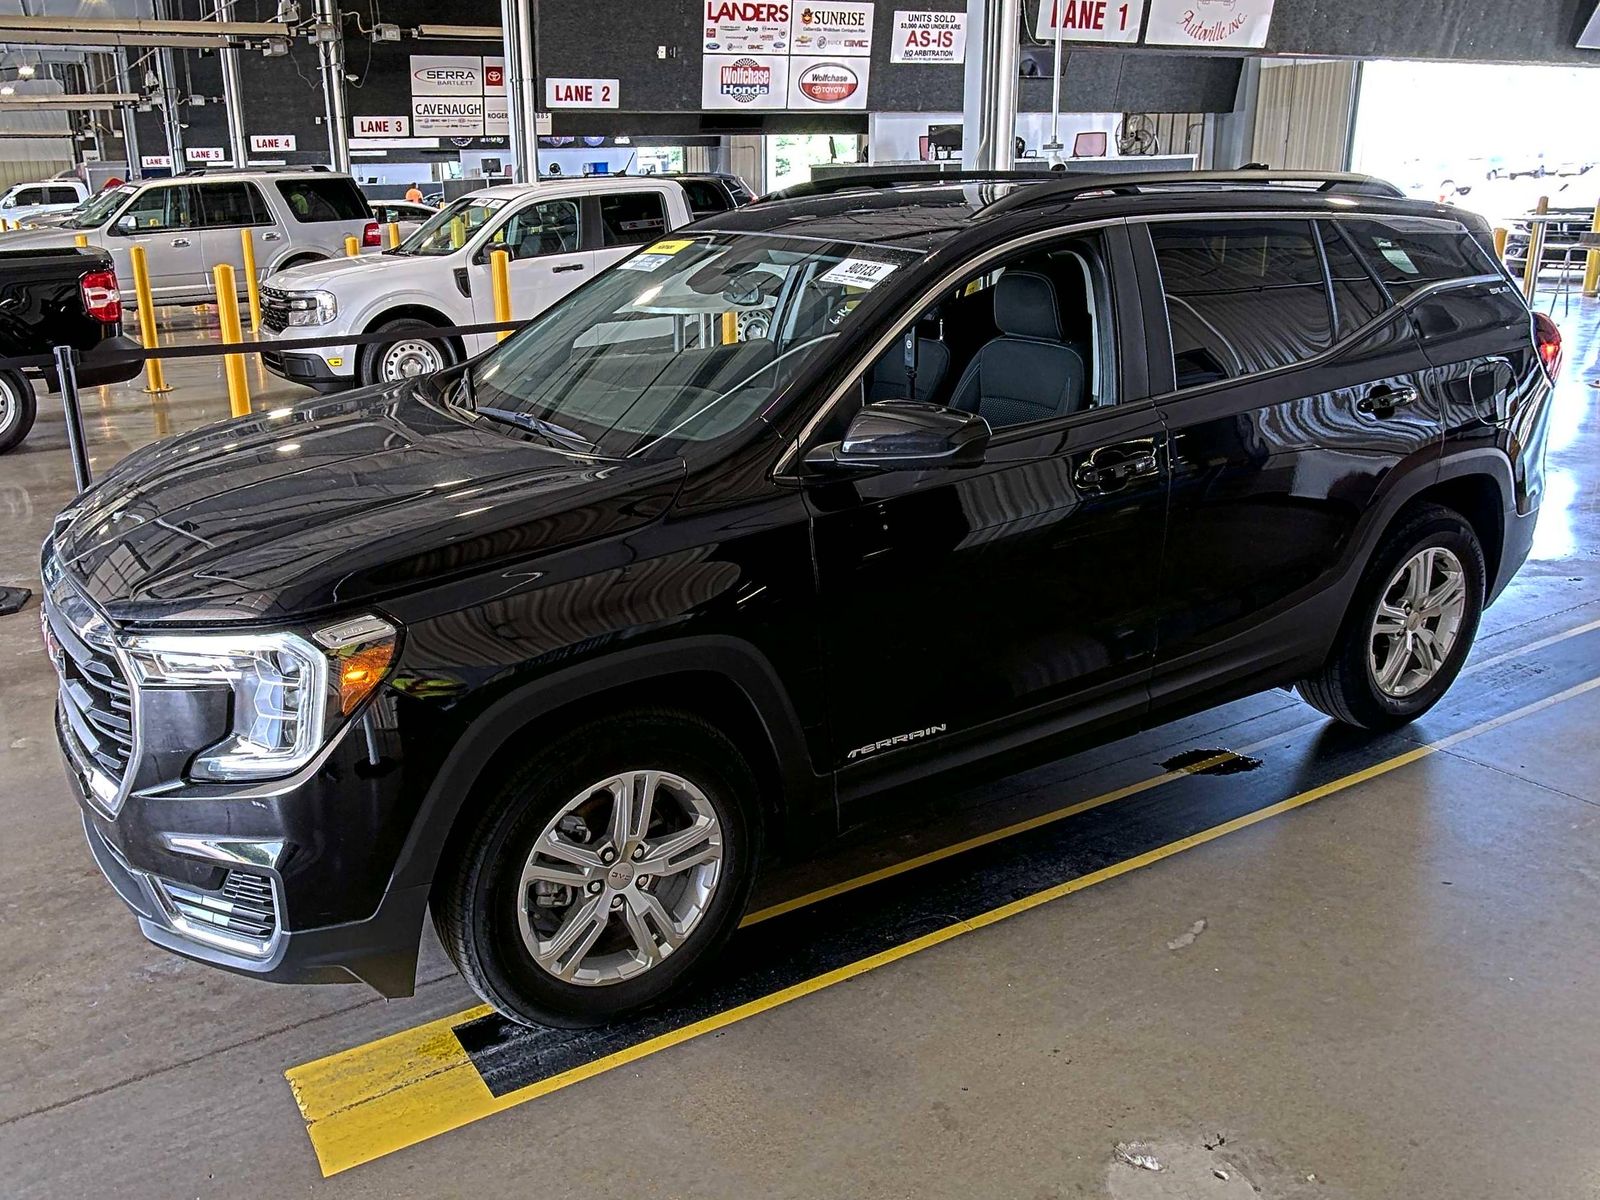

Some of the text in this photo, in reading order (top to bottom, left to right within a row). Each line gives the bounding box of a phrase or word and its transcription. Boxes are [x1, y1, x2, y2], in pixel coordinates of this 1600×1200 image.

[707, 1, 789, 24] LANDERS
[814, 10, 866, 26] SUNRISE
[908, 13, 956, 23] UNITS SOLD
[1119, 3, 1129, 31] 1
[900, 22, 917, 30] $3,000
[1228, 12, 1248, 35] INC.
[843, 39, 868, 48] GMC
[905, 30, 953, 48] AS-IS
[426, 70, 476, 80] SERRA
[722, 67, 769, 85] Wolfchase
[811, 73, 848, 82] Wolfchase
[555, 84, 611, 102] LANE 2
[723, 84, 768, 94] Honda
[415, 103, 482, 115] CAVENAUGH
[360, 120, 402, 133] LANE 3
[256, 138, 290, 149] LANE 4
[190, 150, 220, 159] LANE 5
[146, 158, 163, 166] LANE
[847, 723, 947, 759] TERRAIN
